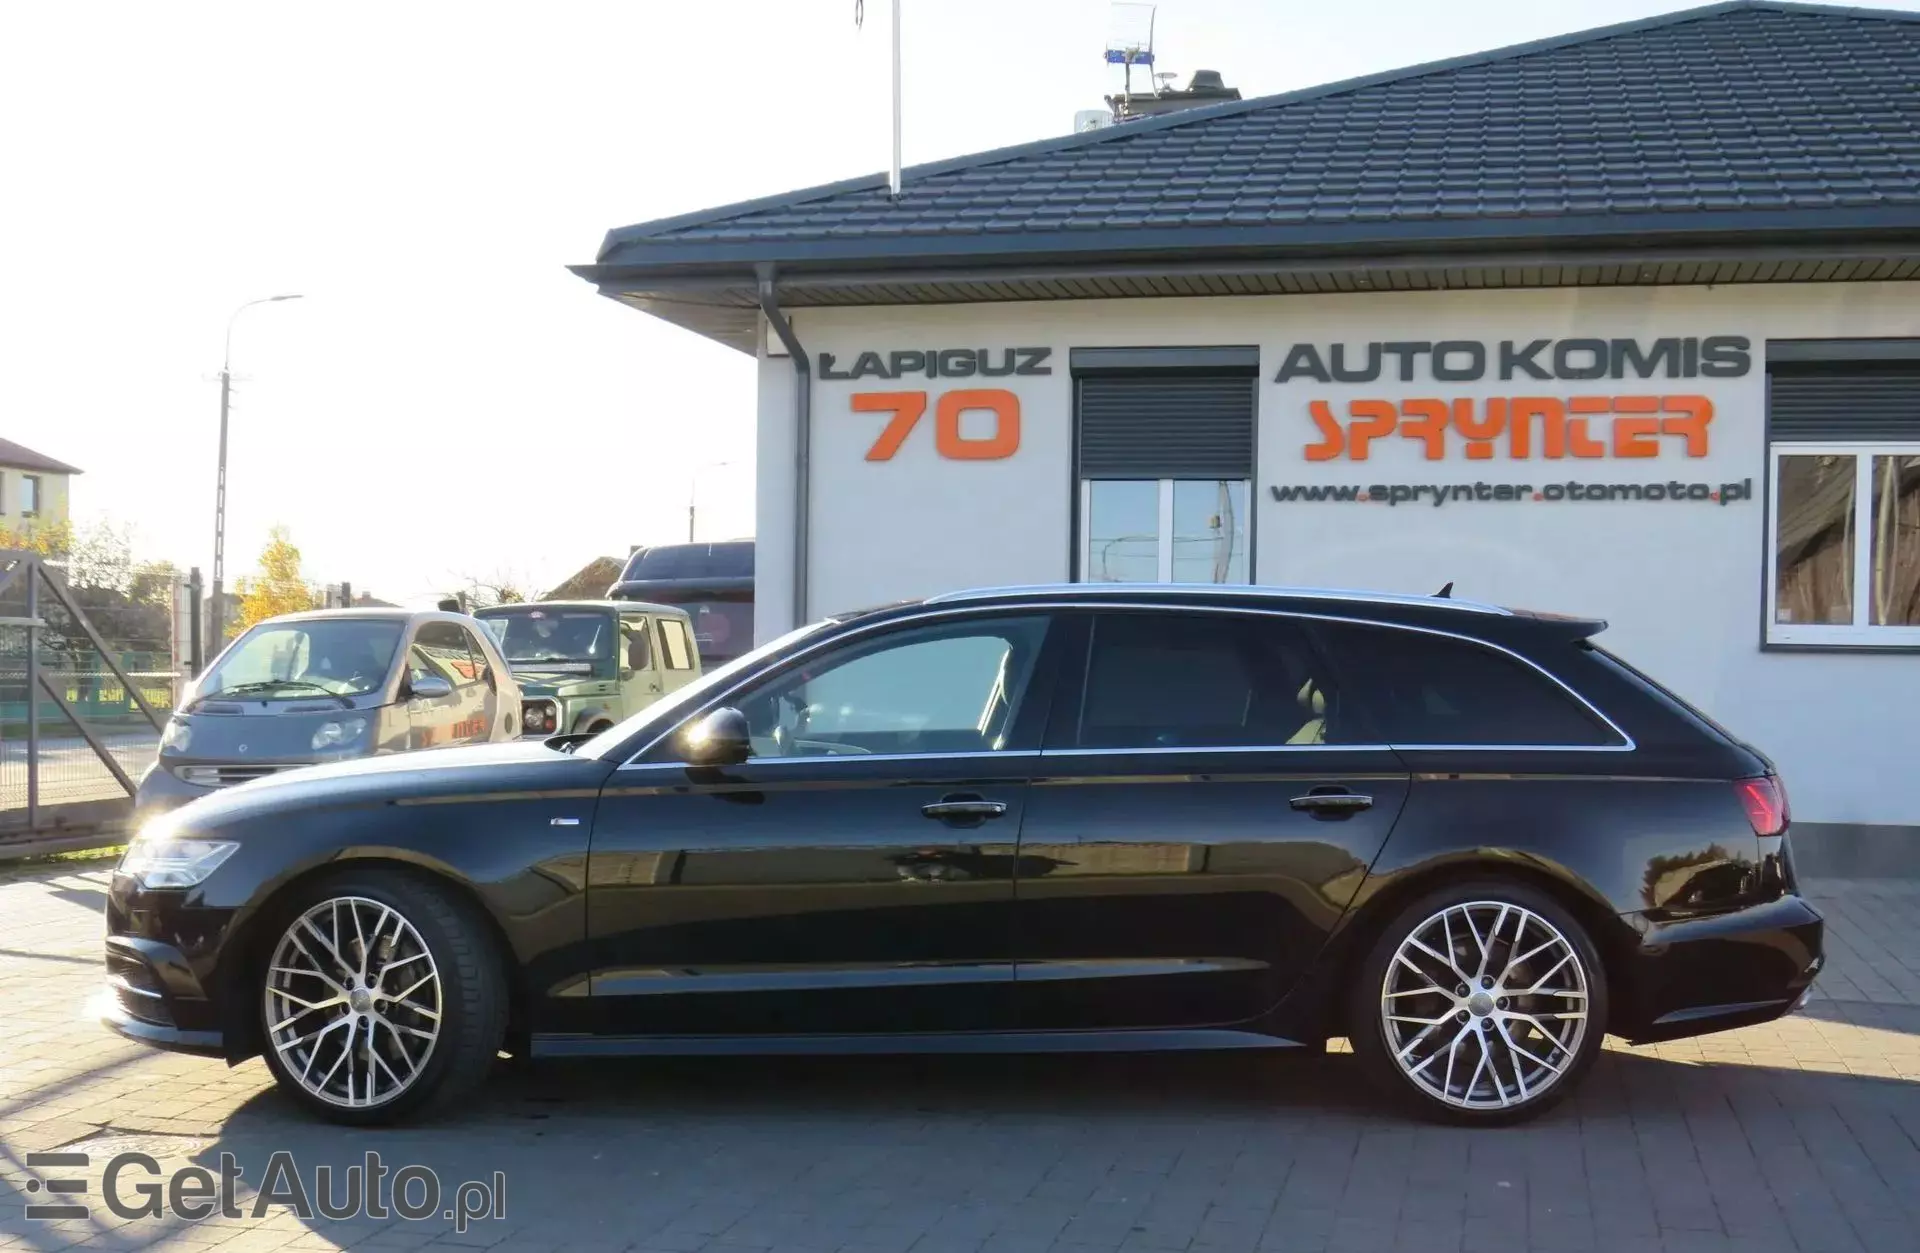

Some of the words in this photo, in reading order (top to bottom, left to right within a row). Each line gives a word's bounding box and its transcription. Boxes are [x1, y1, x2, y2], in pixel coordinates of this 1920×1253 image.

[818, 347, 1052, 379] ŁAPIGUZ
[1274, 340, 1485, 383] AUTO
[1500, 336, 1751, 379] KOMIS
[851, 389, 1021, 461] 70
[1304, 395, 1714, 461] SPRYNTER
[1271, 478, 1752, 506] www.sprynter.otomoto.pl
